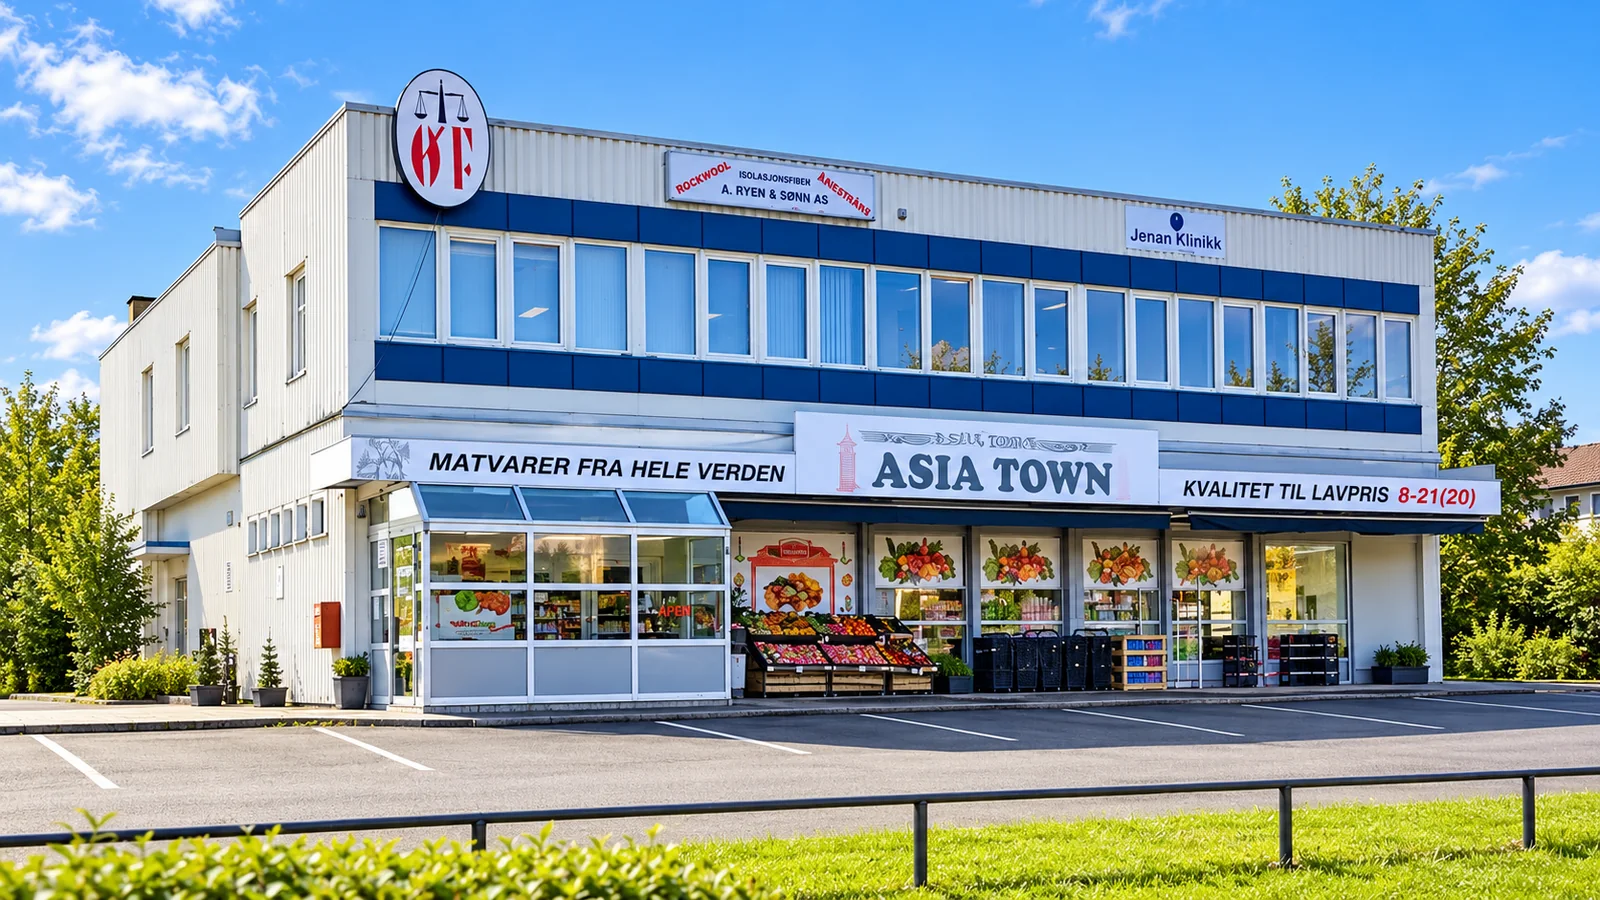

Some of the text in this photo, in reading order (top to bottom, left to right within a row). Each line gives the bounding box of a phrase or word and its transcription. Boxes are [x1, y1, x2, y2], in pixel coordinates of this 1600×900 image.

[675, 161, 731, 194] ROCKWOOL
[721, 184, 829, 205] A. RYEN & SØNN AS
[1130, 228, 1222, 250] Jenan Klinikk
[429, 452, 786, 483] MATVARER FRA HELE VERDEN
[871, 451, 1113, 496] ASIA TOWN
[1183, 480, 1477, 509] KVALITET TIL LAVPRIS 8-21(20)
